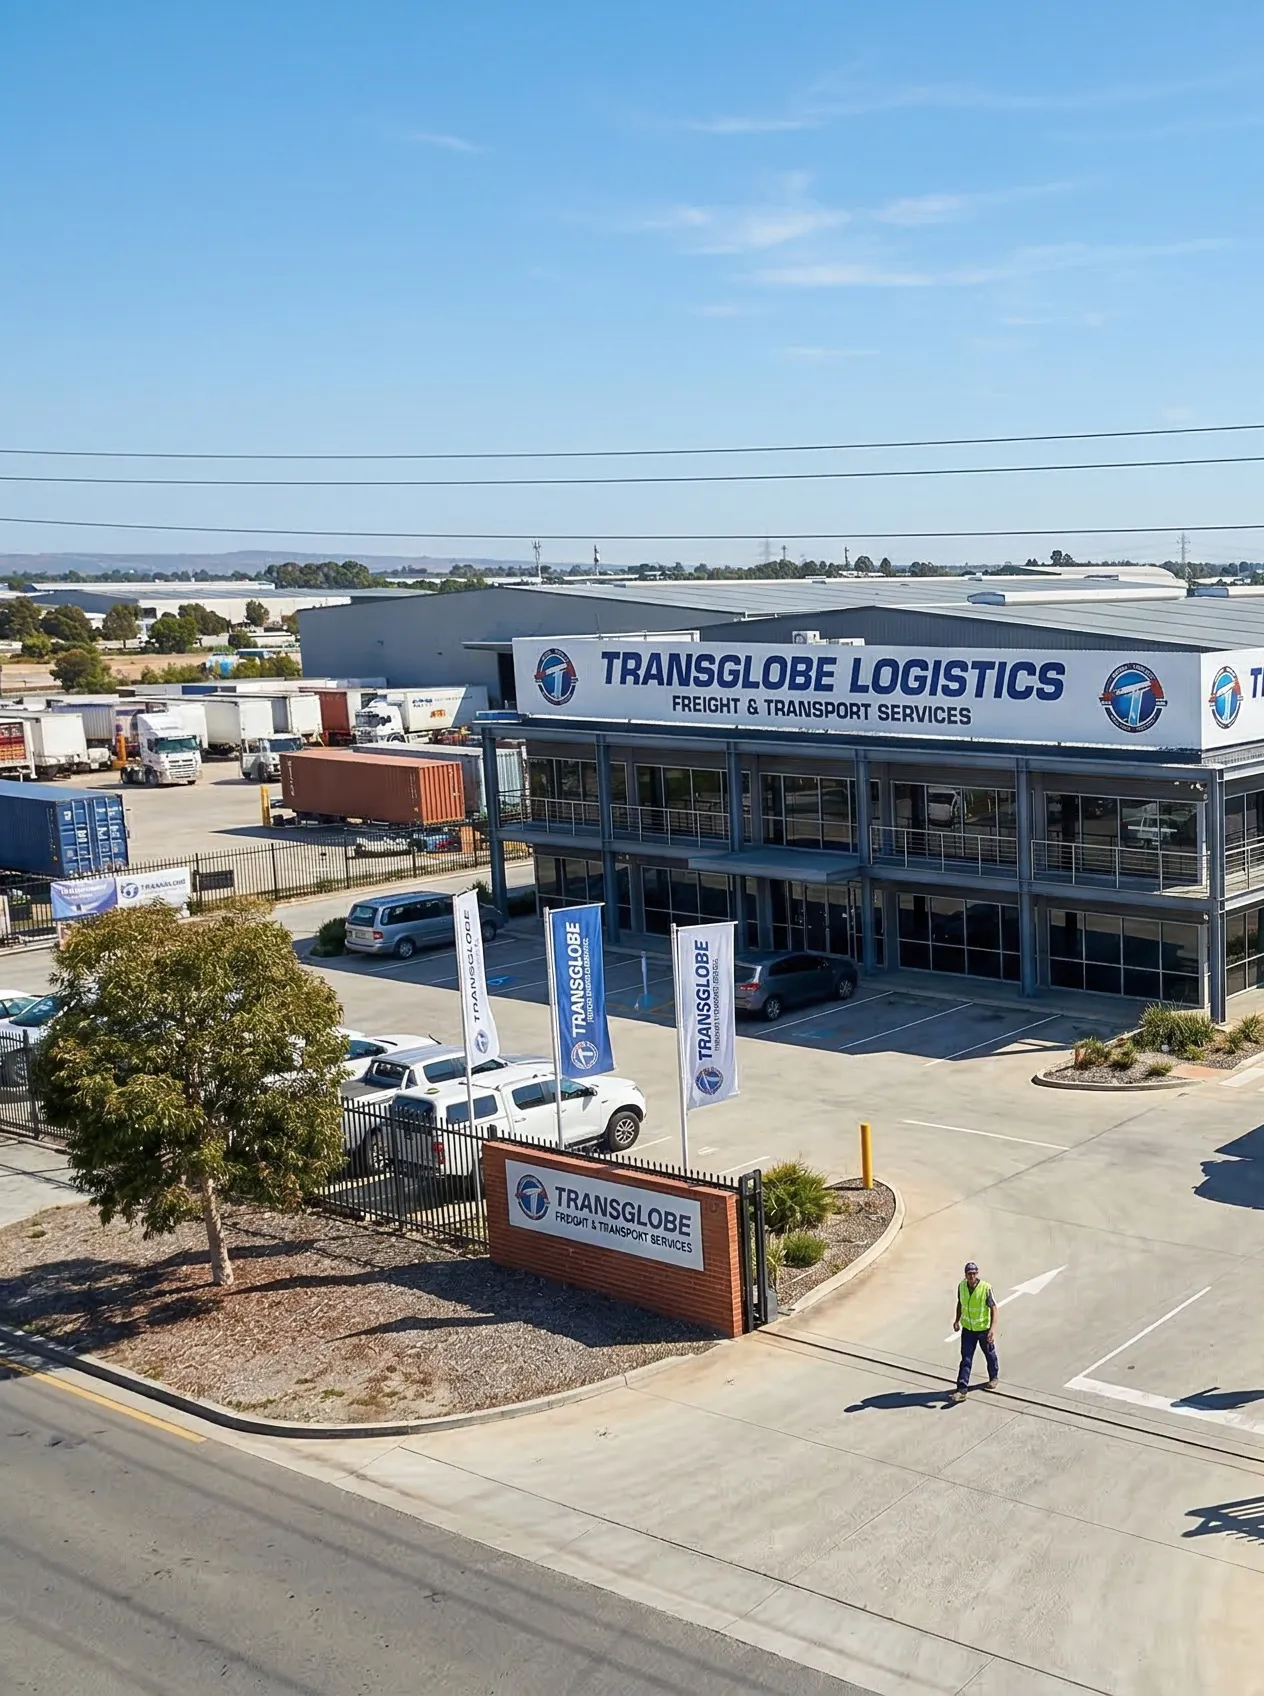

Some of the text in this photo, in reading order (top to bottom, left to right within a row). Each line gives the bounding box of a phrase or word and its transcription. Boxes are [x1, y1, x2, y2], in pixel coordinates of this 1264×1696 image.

[601, 650, 1066, 701] TRANSGLOBE LOGISTICS
[672, 695, 973, 726] FREIGHT & TRANSPORT SERVICES
[566, 922, 586, 1037] TRANSGLOBE
[695, 940, 712, 1061] TRANSGLOBE
[555, 1186, 692, 1237] TRANSGLOBE
[650, 1234, 693, 1253] SERVICES
